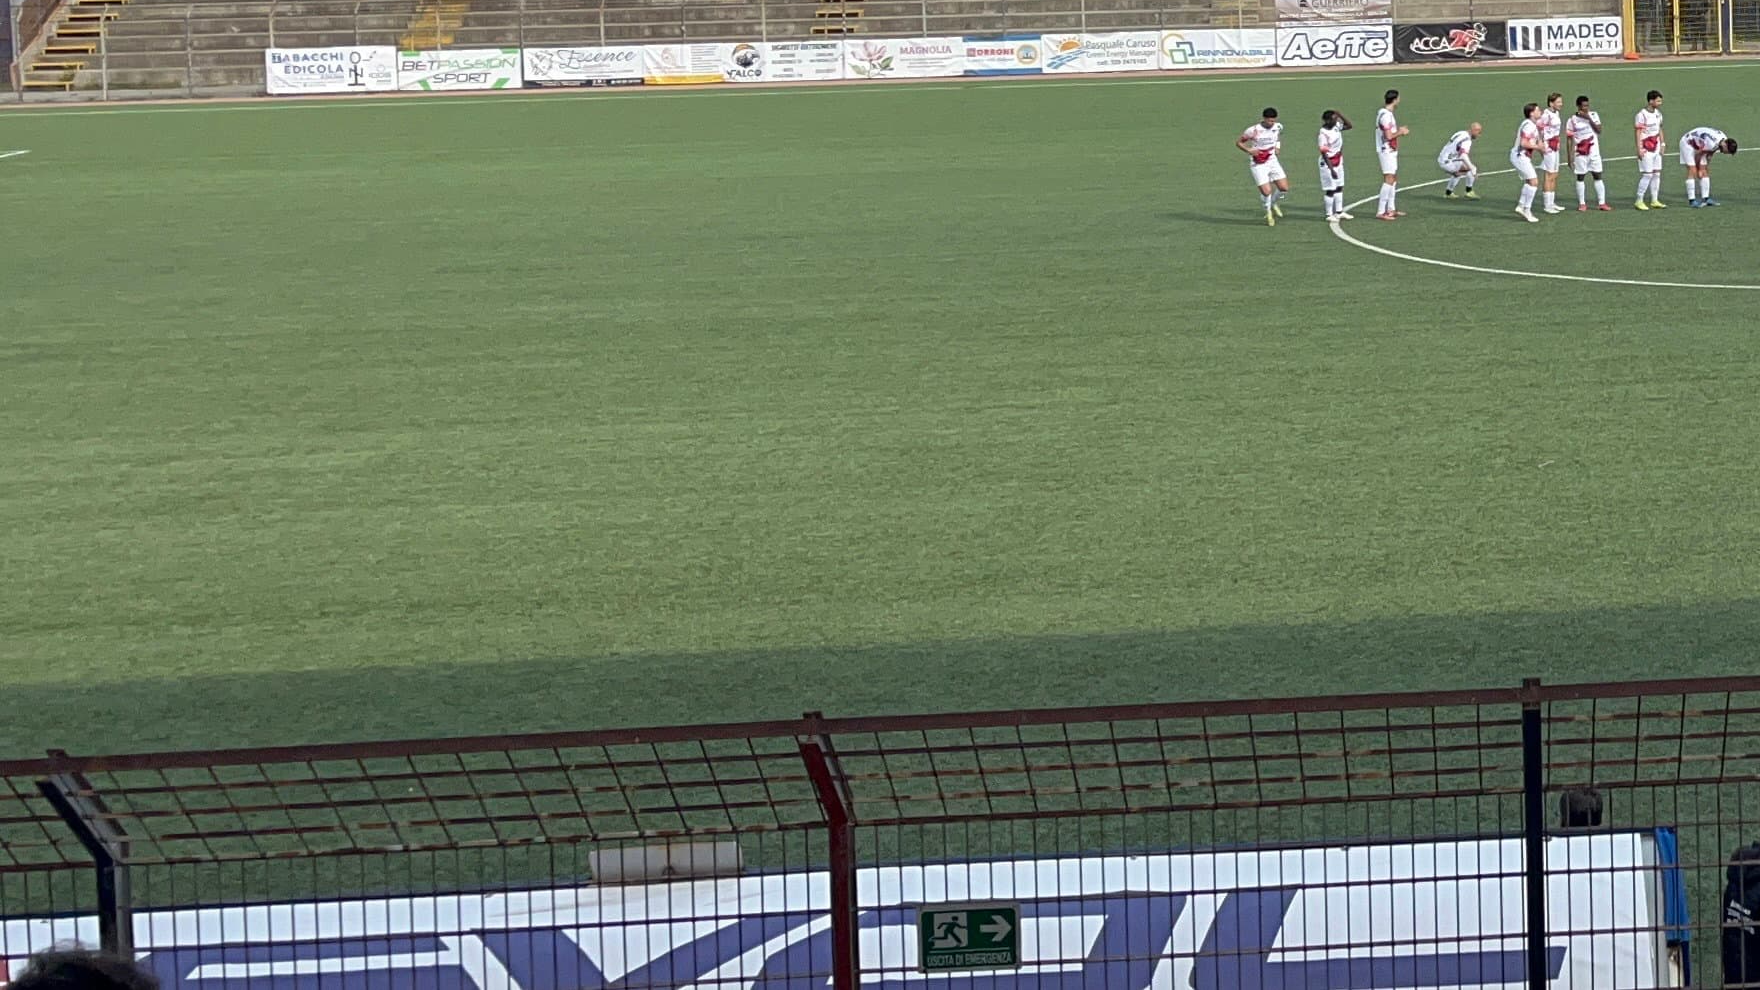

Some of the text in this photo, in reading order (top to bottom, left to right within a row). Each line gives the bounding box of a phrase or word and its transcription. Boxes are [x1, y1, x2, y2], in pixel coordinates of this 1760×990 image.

[1547, 22, 1619, 40] MADEO
[899, 45, 953, 55] MAGNOLIA
[1085, 38, 1156, 51] Pasquale Caruso
[1281, 30, 1389, 61] Aeffe
[1547, 41, 1618, 51] IMPIANTI
[284, 64, 344, 74] EDICOLA
[402, 57, 516, 70] BETPASSION
[432, 72, 491, 83] SPORT
[926, 952, 1012, 967] USCITA DI EMERGENZA
